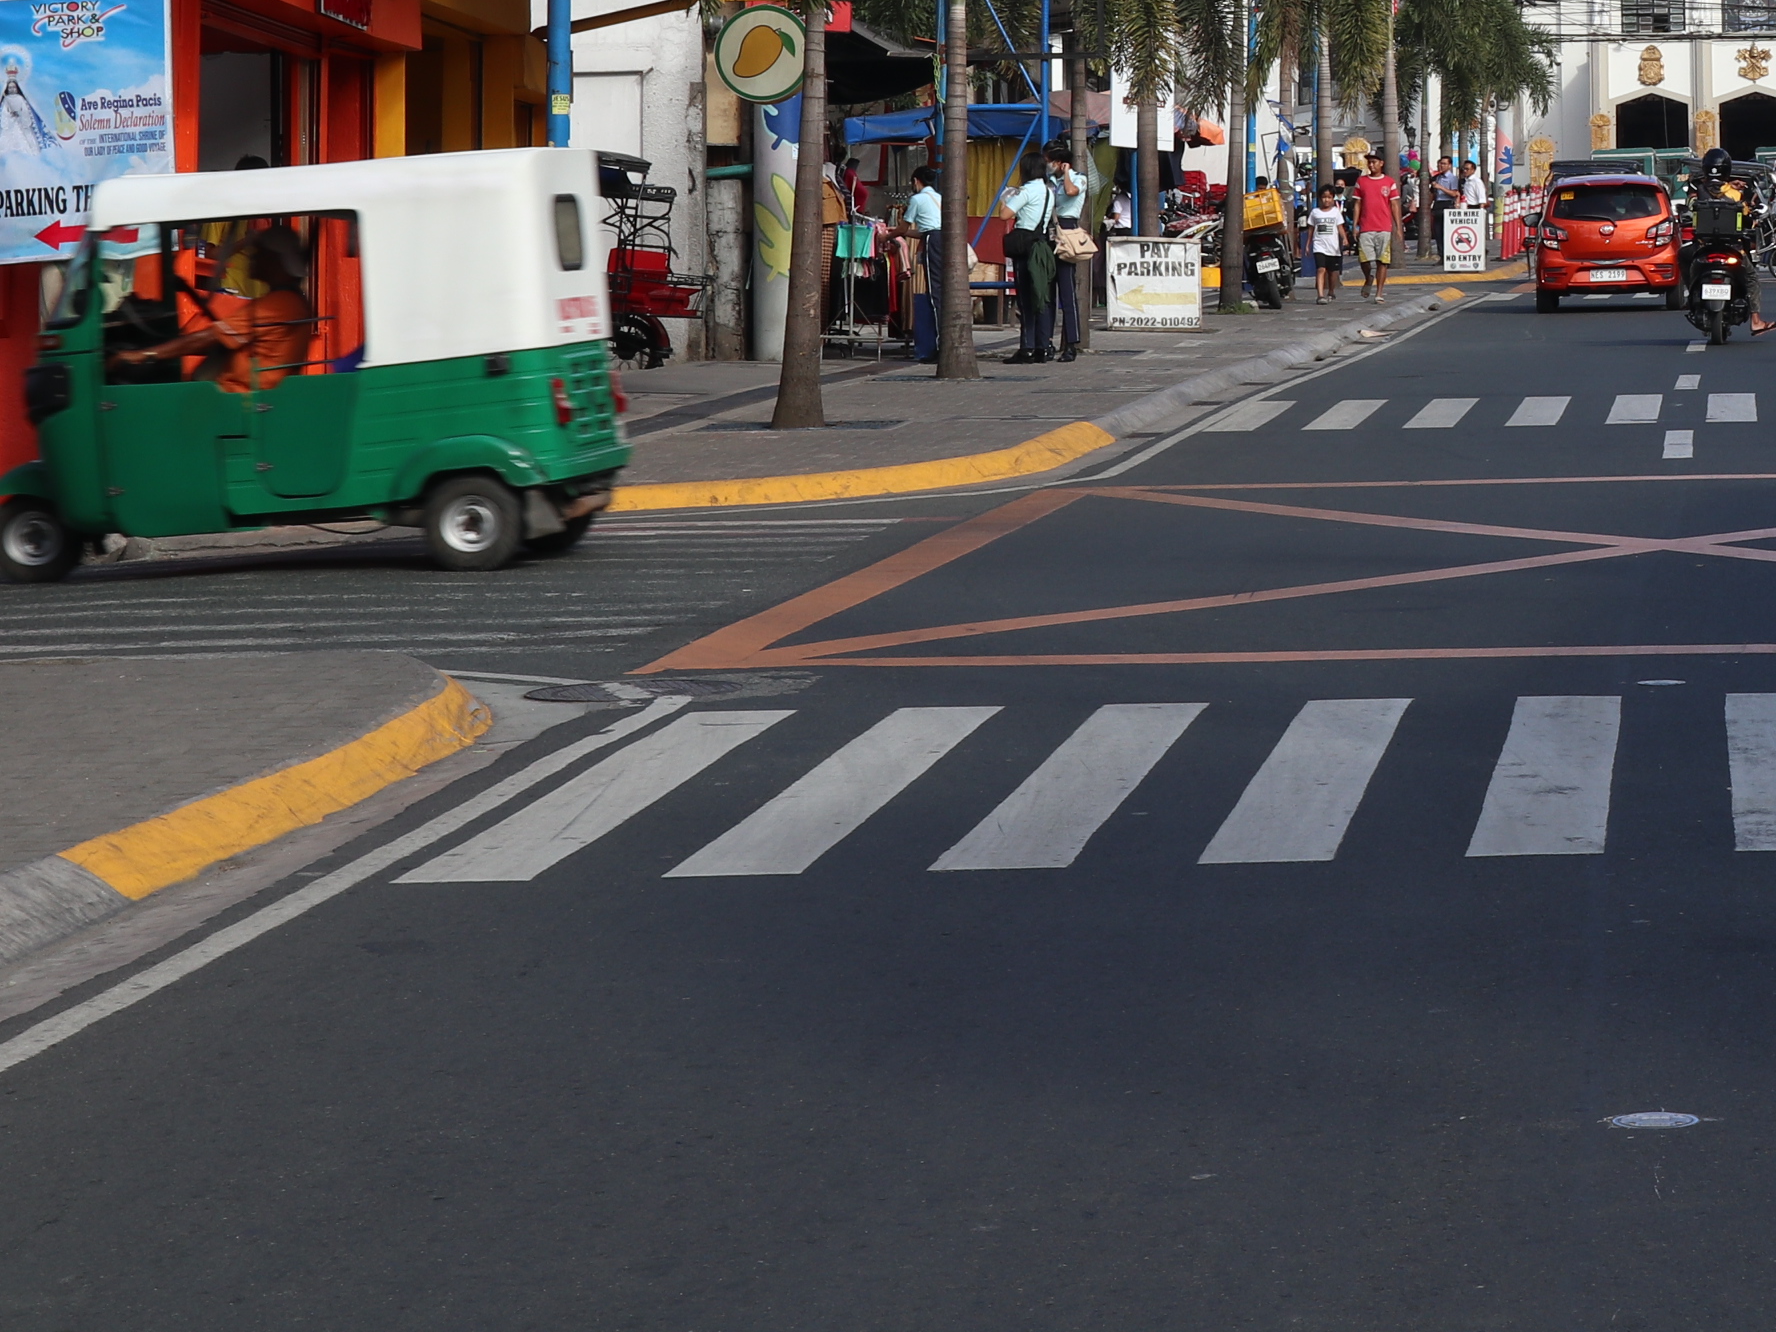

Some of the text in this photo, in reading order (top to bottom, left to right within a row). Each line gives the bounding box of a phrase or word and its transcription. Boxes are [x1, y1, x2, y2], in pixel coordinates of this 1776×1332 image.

[32, 0, 99, 14] VICTORY
[47, 13, 101, 26] PARK &
[61, 26, 104, 39] SHOP
[81, 93, 161, 112] Ave Regina Pacis
[79, 110, 165, 132] Solemn Declaration
[99, 132, 137, 143] INTERNATIONAL
[139, 130, 157, 140] SHRINE
[159, 130, 165, 139] OF
[84, 146, 93, 157] OUR
[94, 146, 106, 156] LADY
[112, 144, 125, 154] PEACE
[126, 143, 135, 153] AND
[136, 142, 147, 152] GOOD
[148, 142, 166, 152] VOYAGE
[1140, 243, 1172, 258] PAY
[1117, 261, 1195, 277] PARKING
[1112, 317, 1199, 327] PN-2022-010492
